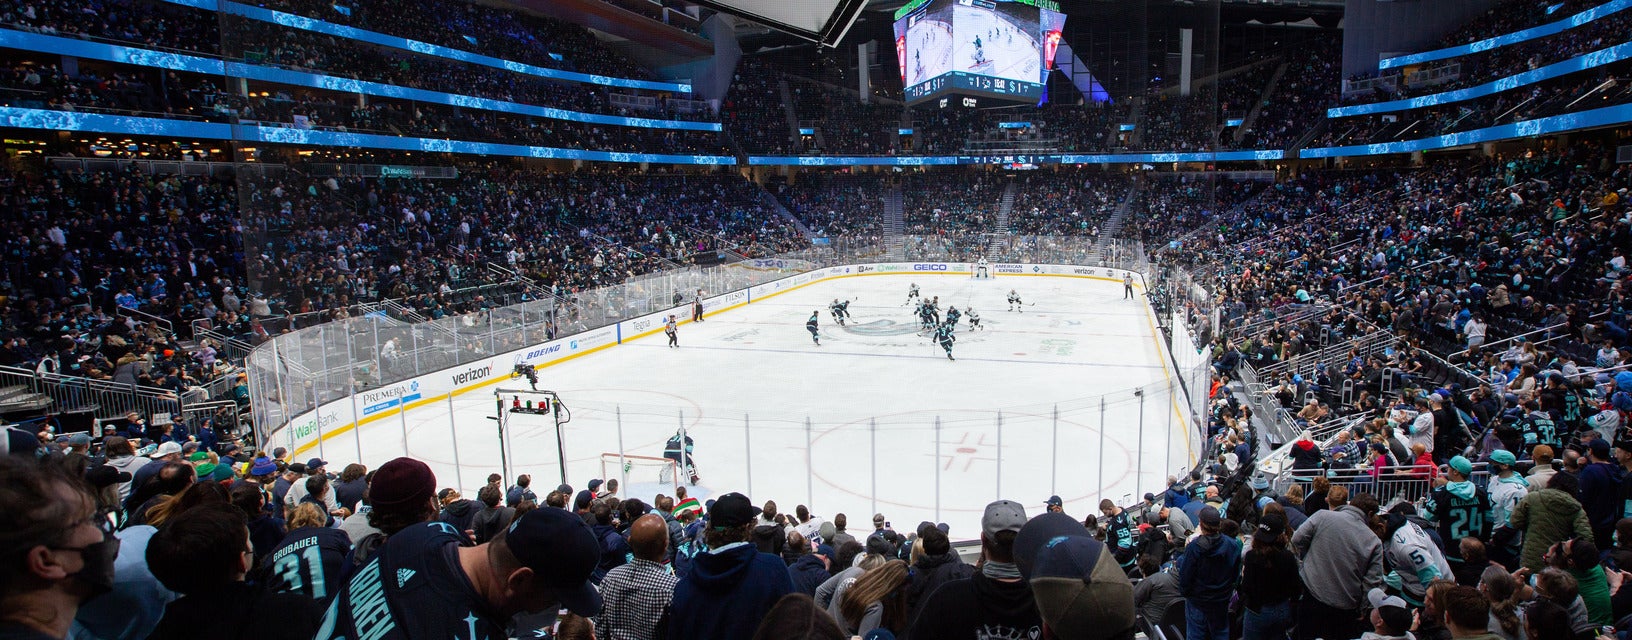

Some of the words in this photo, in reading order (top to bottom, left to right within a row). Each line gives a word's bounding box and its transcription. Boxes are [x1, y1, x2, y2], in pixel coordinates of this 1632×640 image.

[1034, 0, 1060, 12] ARENA
[726, 292, 744, 302] FILSON
[633, 319, 650, 331] Tegna
[526, 344, 561, 360] BOEING
[452, 366, 490, 385] verizon
[364, 385, 406, 405] PREMERA
[1538, 426, 1556, 444] 32
[1450, 507, 1482, 539] 24
[1116, 528, 1129, 538] 55
[274, 536, 318, 562] GRUBAUER
[274, 545, 326, 599] 31
[349, 556, 396, 640] KRAKEN
